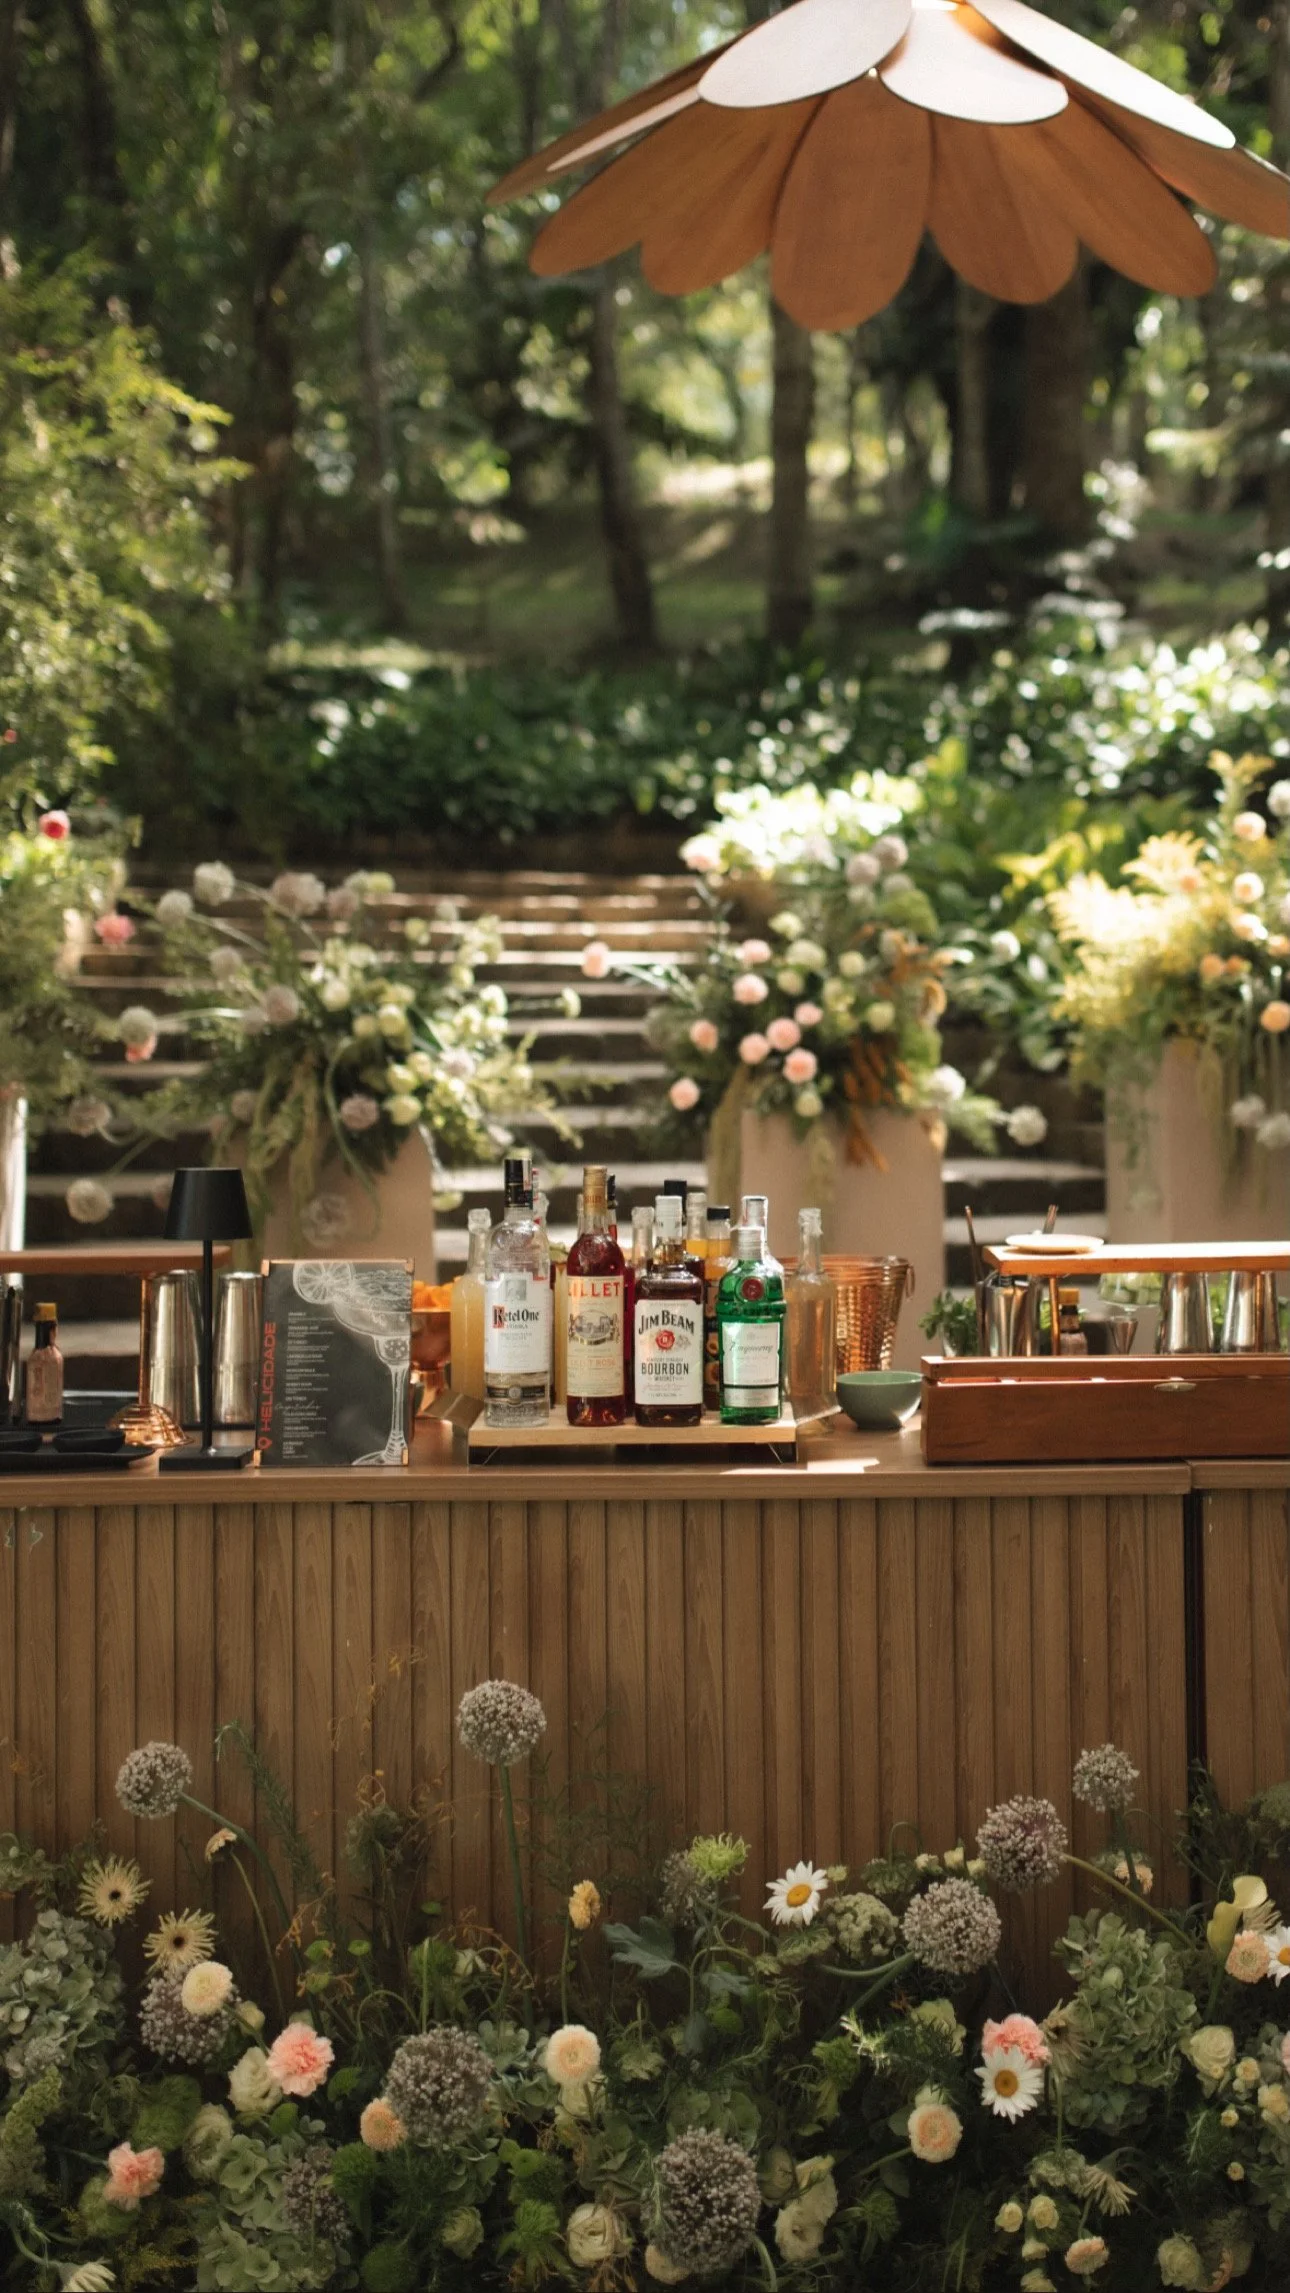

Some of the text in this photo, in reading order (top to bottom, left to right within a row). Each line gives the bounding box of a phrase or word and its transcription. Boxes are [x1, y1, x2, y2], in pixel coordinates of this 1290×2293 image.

[494, 1308, 539, 1325] Ketel One
[639, 1310, 695, 1334] JIM BEAM
[729, 1341, 773, 1354] Tnqueray
[260, 1321, 276, 1432] HELICIDADE
[641, 1363, 689, 1375] BOURBON
